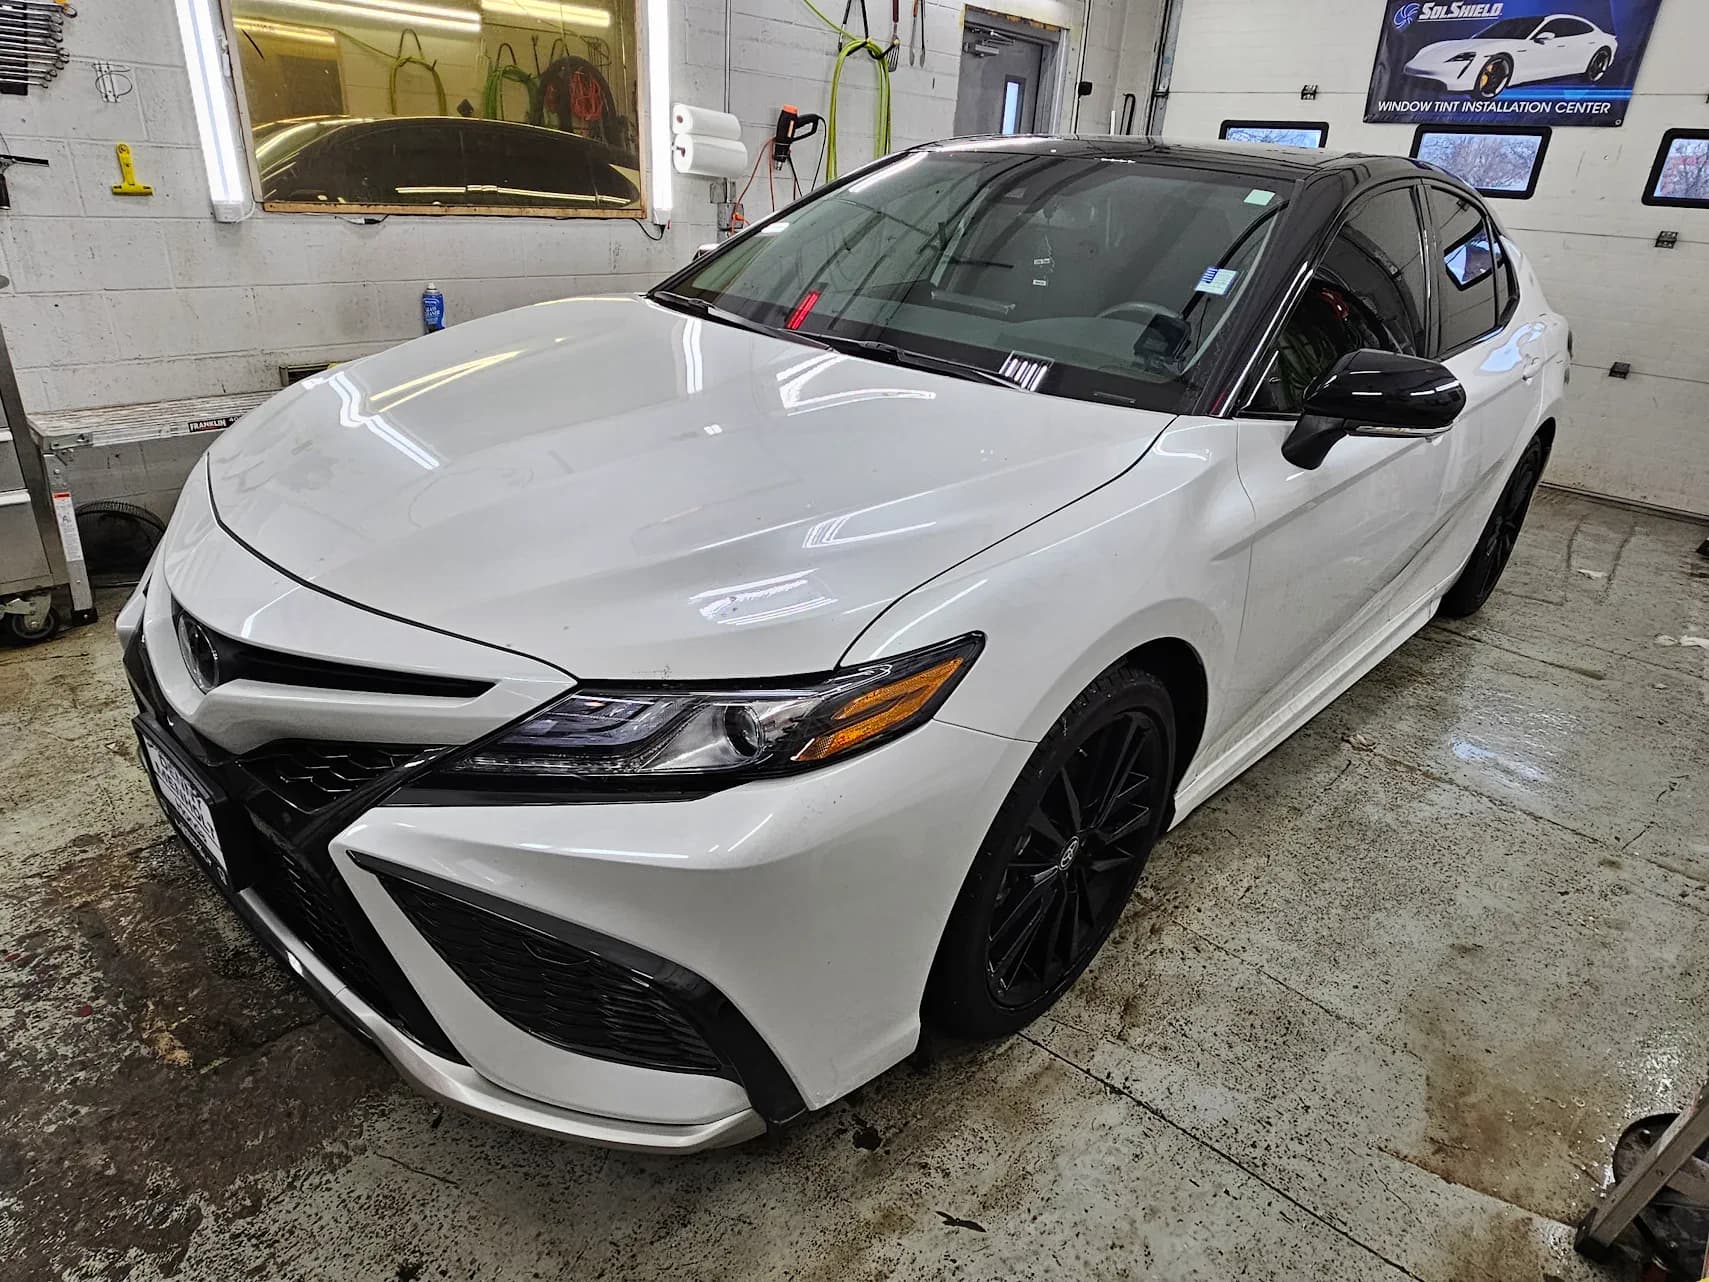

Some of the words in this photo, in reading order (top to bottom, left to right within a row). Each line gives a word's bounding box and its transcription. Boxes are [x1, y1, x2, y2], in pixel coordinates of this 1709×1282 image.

[1378, 101, 1432, 112] WINDOW
[1434, 101, 1460, 112] TINT
[1462, 101, 1552, 113] INSTALLATION
[1555, 102, 1611, 113] CENTER
[190, 419, 227, 431] FRANKLIN
